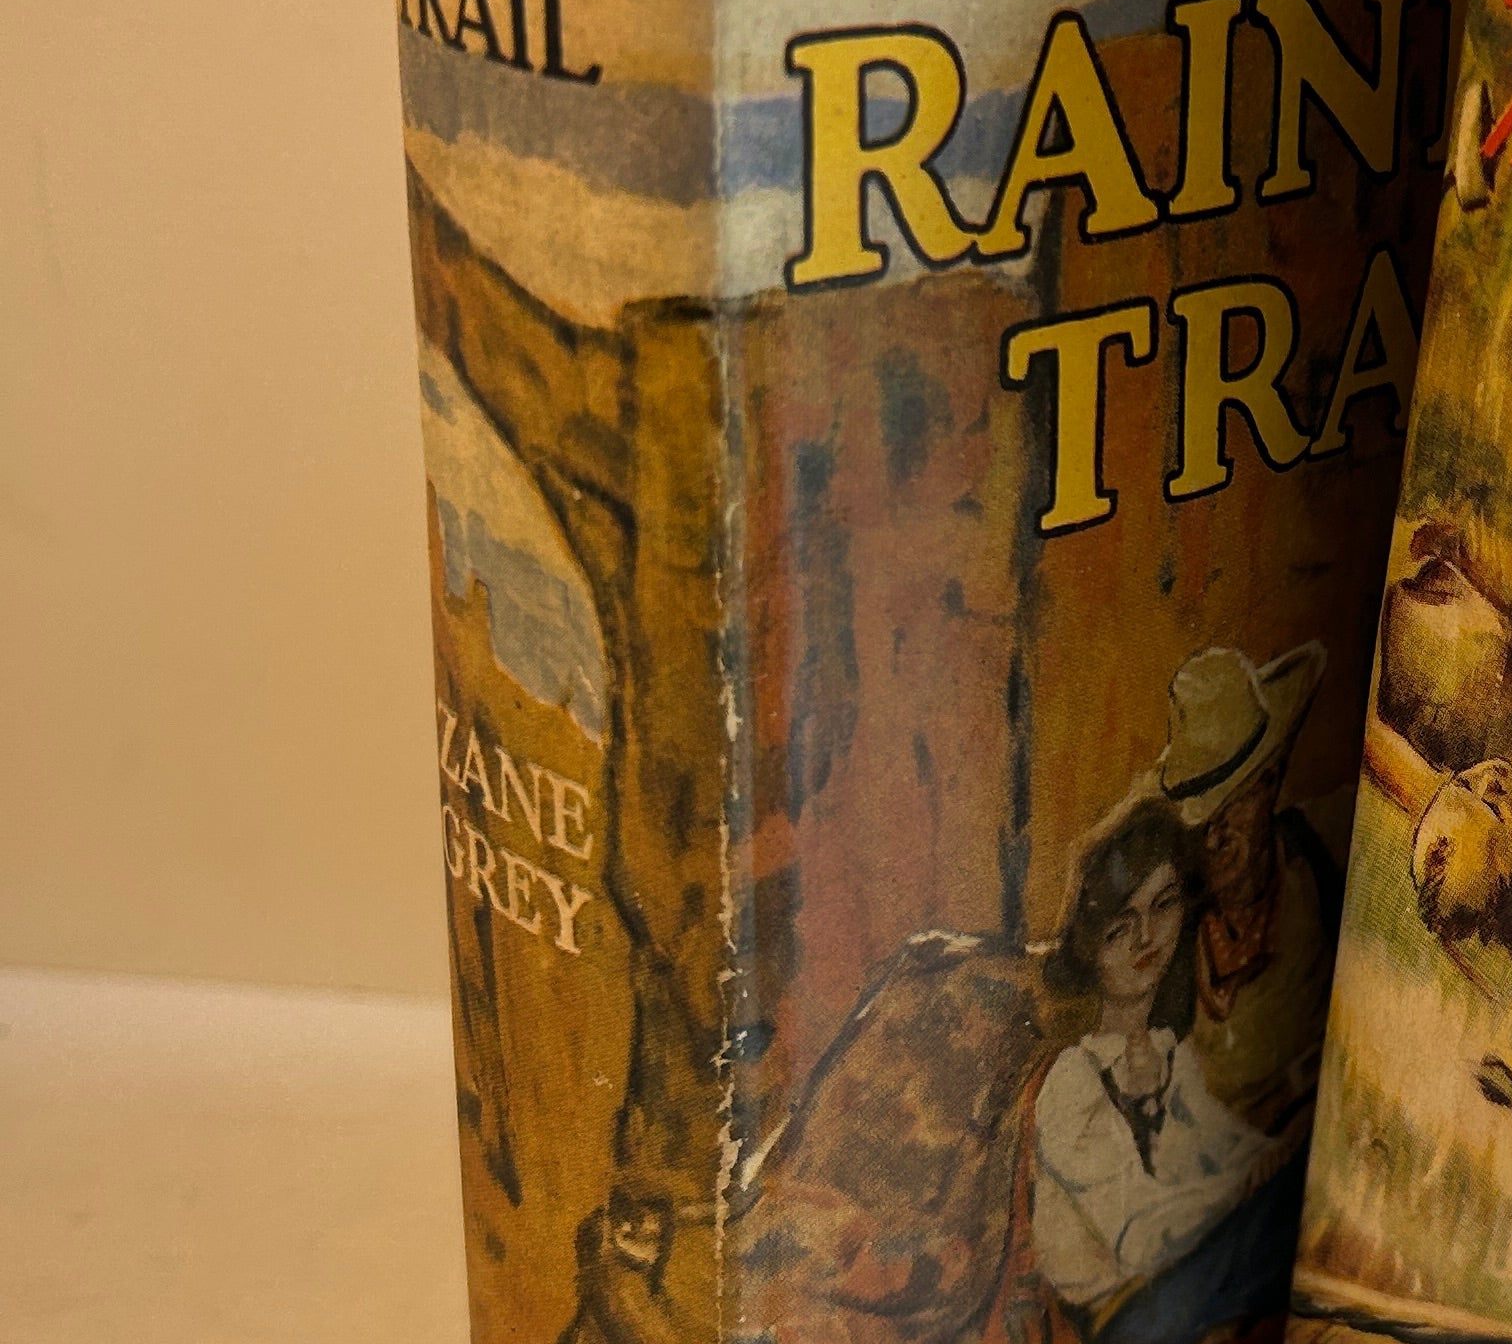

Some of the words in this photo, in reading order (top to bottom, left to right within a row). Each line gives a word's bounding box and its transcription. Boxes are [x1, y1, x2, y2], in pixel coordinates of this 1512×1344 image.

[1001, 241, 1428, 540] TRA
[437, 699, 594, 861] ZANE
[443, 805, 594, 956] GREY
